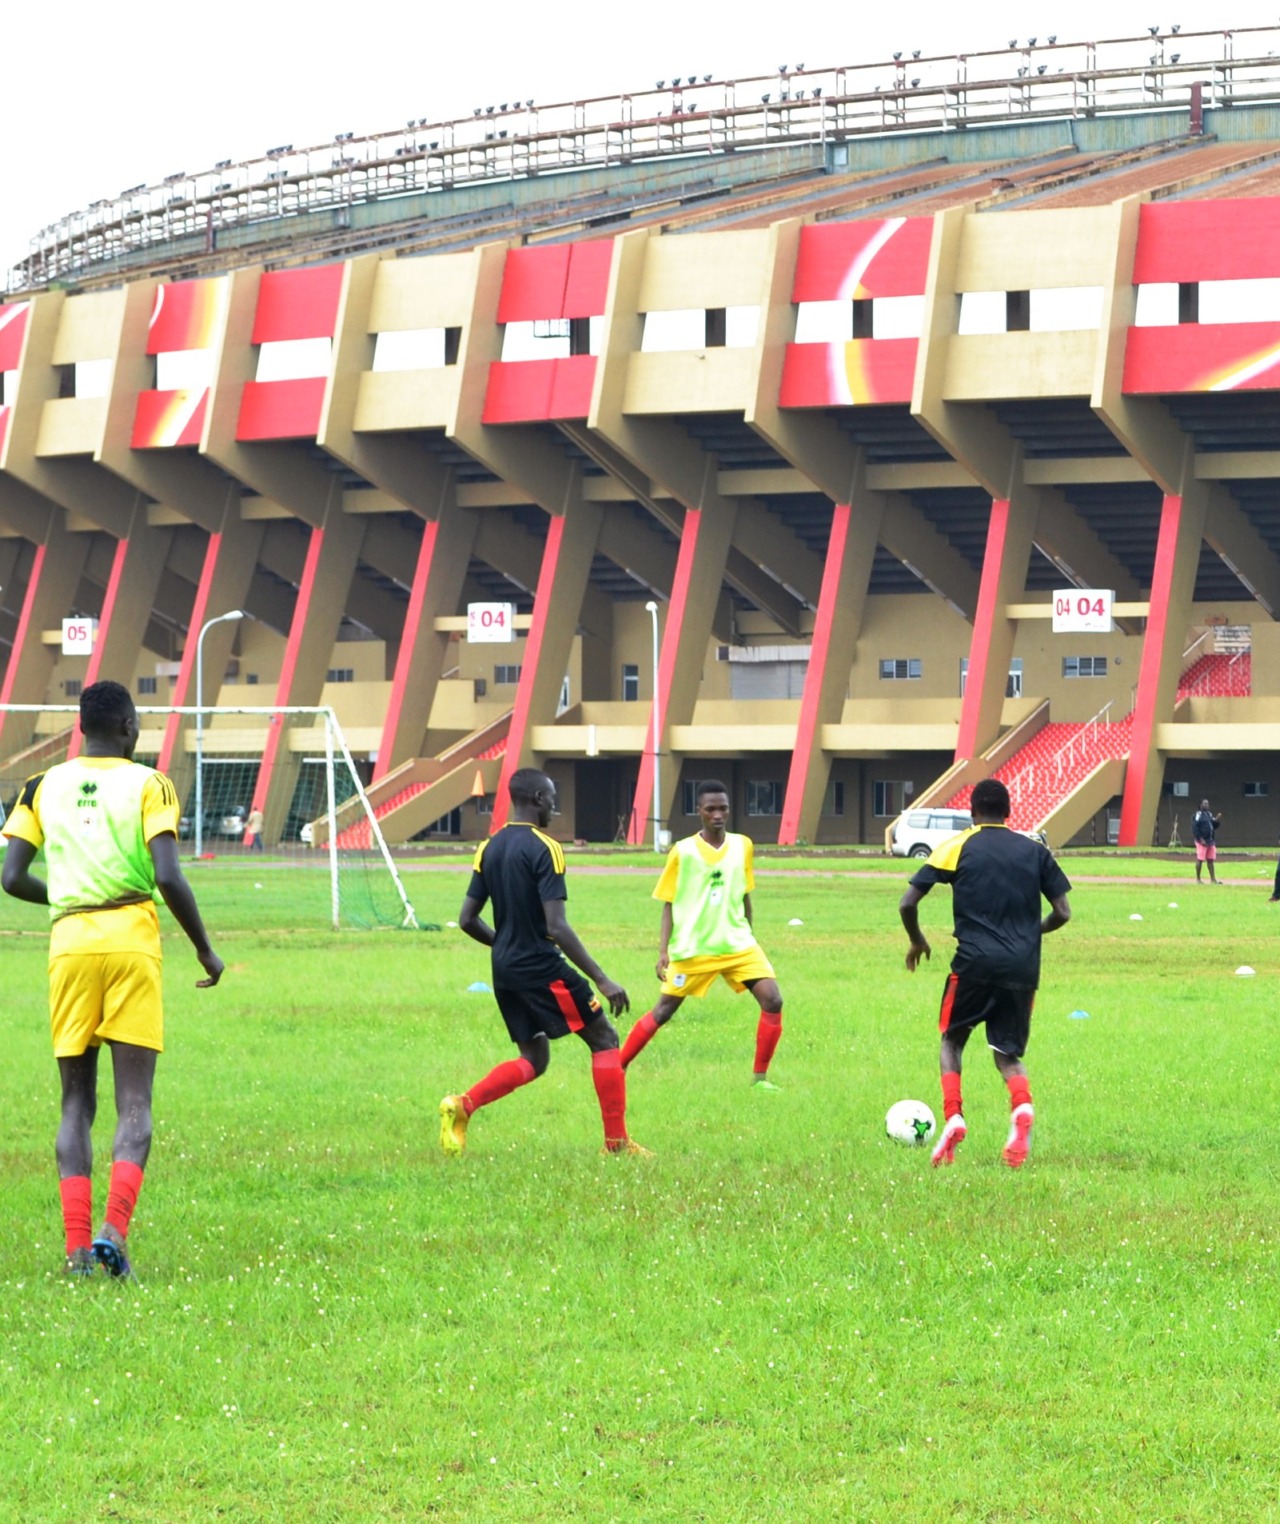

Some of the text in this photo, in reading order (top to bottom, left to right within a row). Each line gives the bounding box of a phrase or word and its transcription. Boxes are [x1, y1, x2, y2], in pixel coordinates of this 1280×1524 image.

[1056, 598, 1070, 616] 04
[1077, 597, 1105, 616] 04
[481, 610, 505, 627] 04
[67, 625, 87, 641] 05
